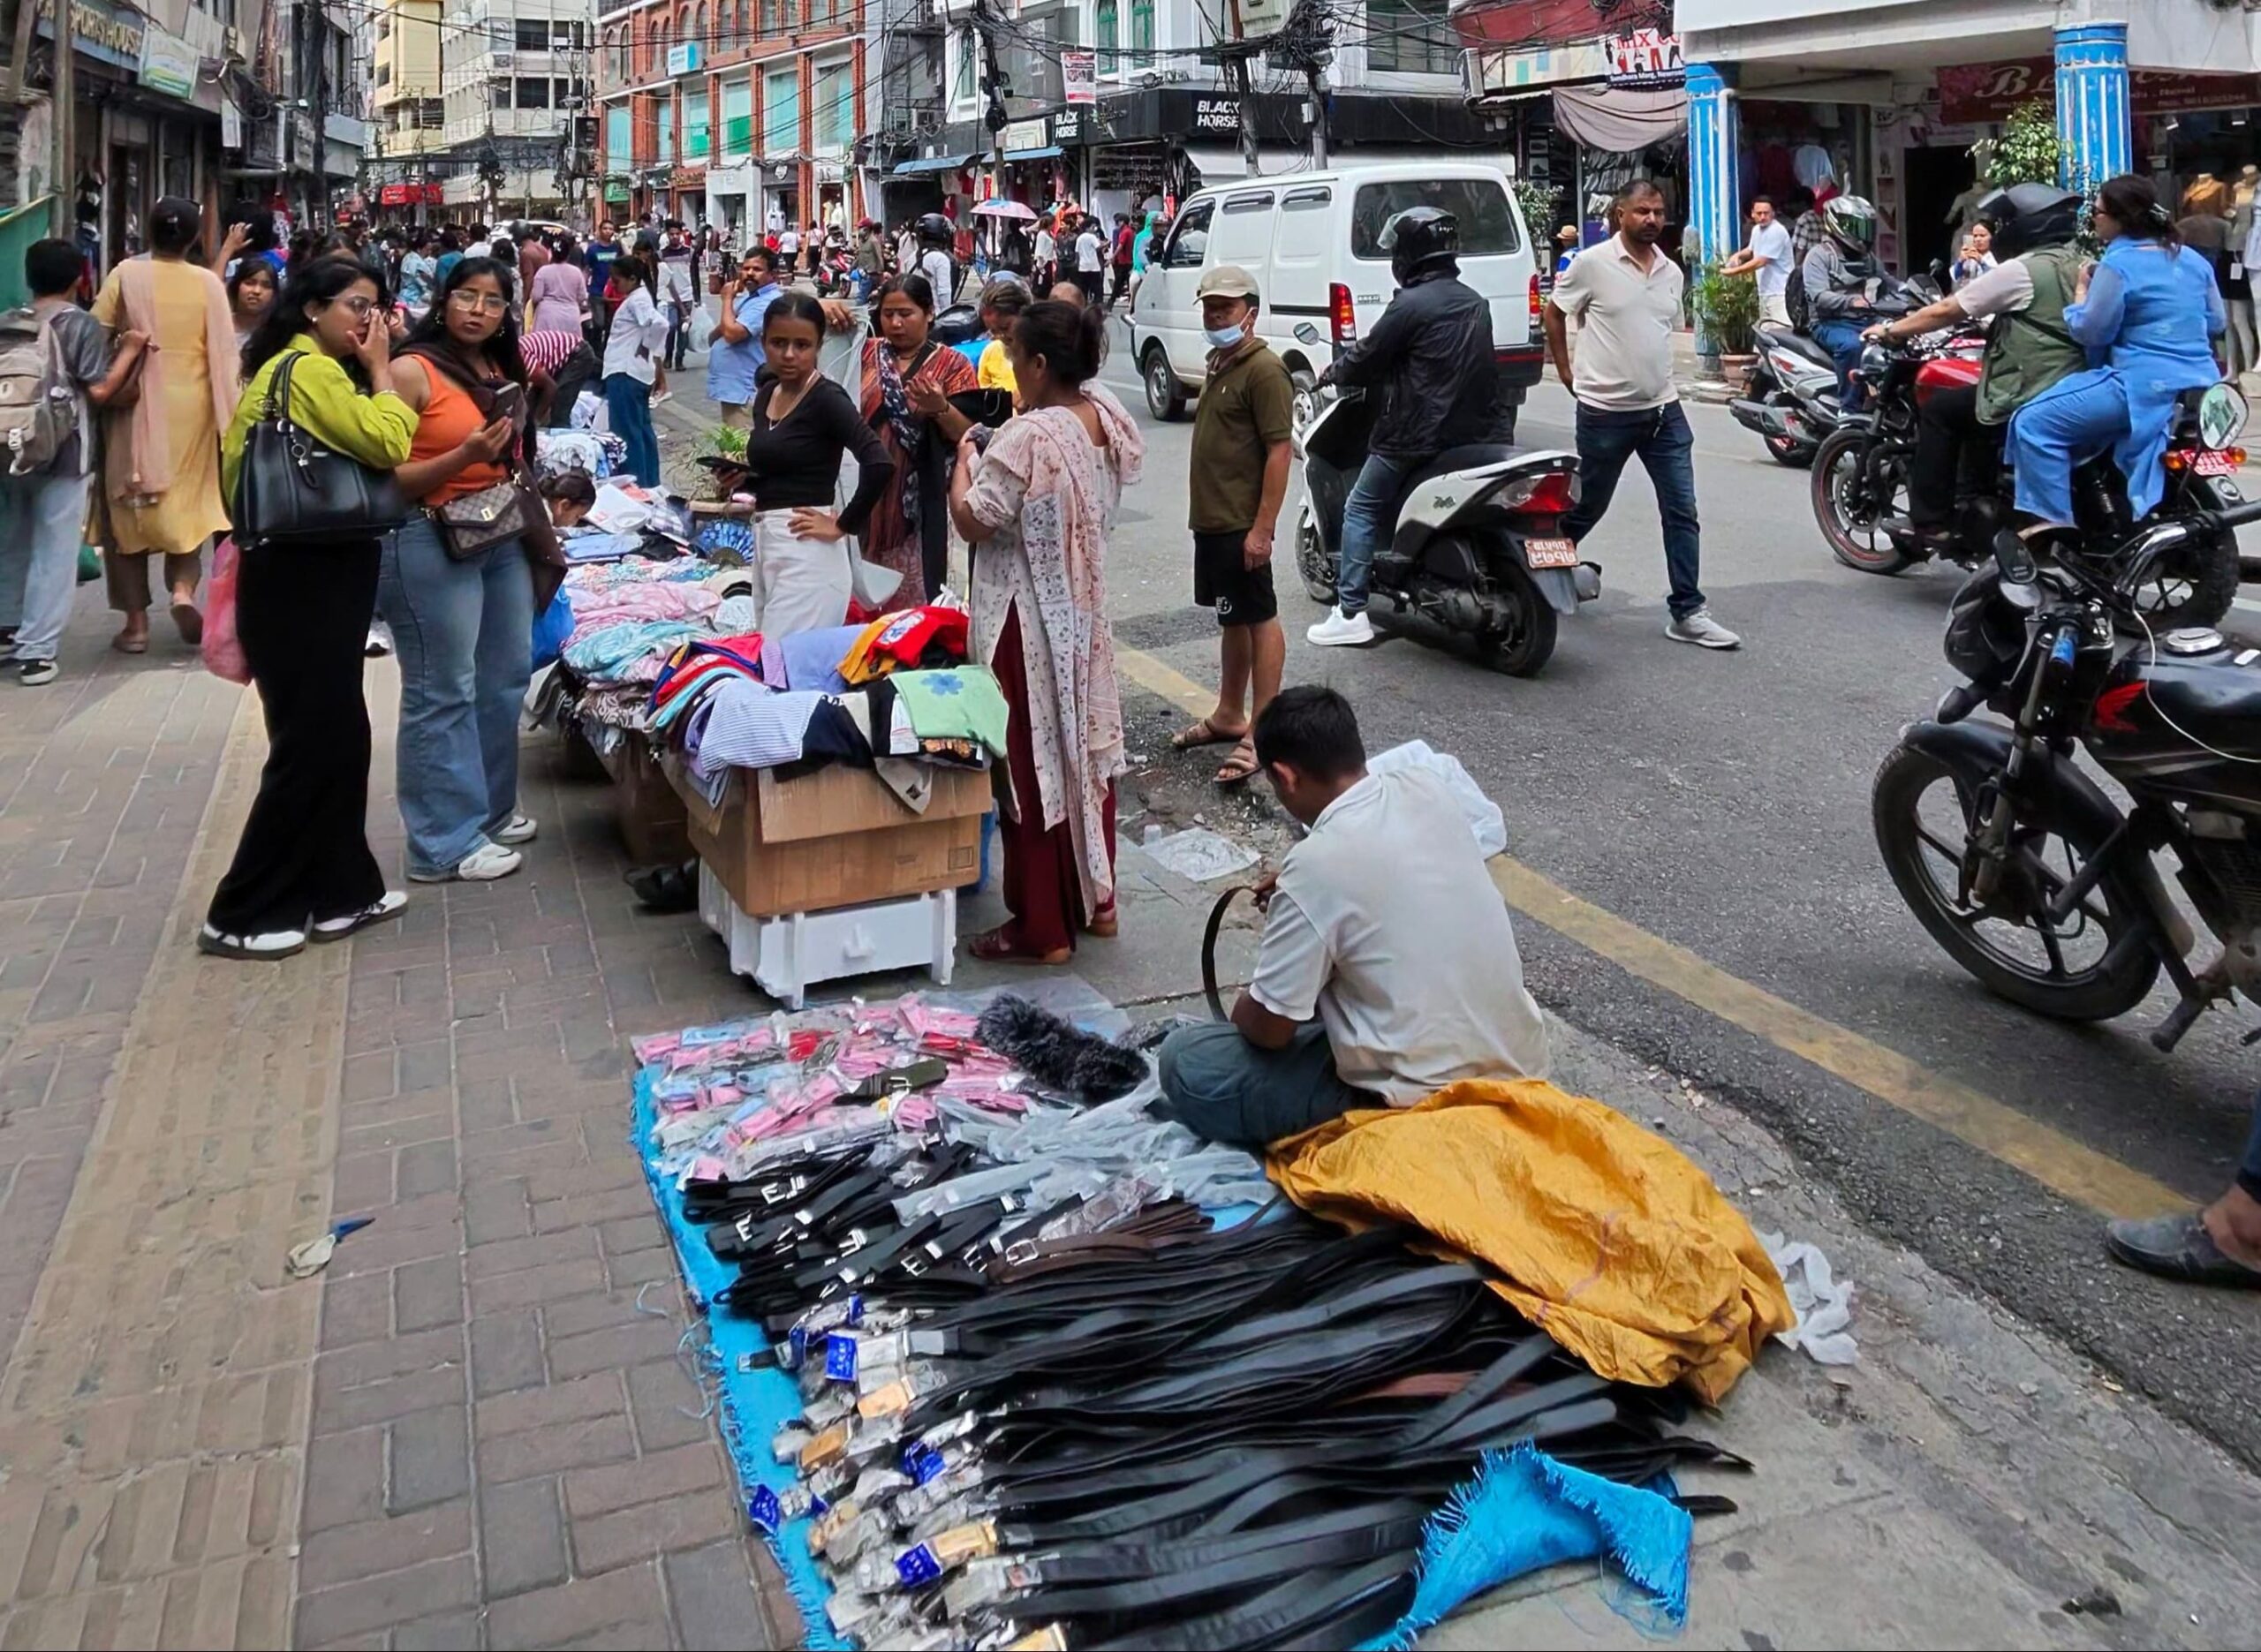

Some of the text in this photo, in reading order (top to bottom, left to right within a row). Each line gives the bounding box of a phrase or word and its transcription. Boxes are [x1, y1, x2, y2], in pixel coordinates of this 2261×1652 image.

[1197, 100, 1240, 114] BLACK
[1055, 110, 1078, 125] BLACK
[1197, 114, 1239, 128] HORSE
[1055, 125, 1078, 139] HORSE
